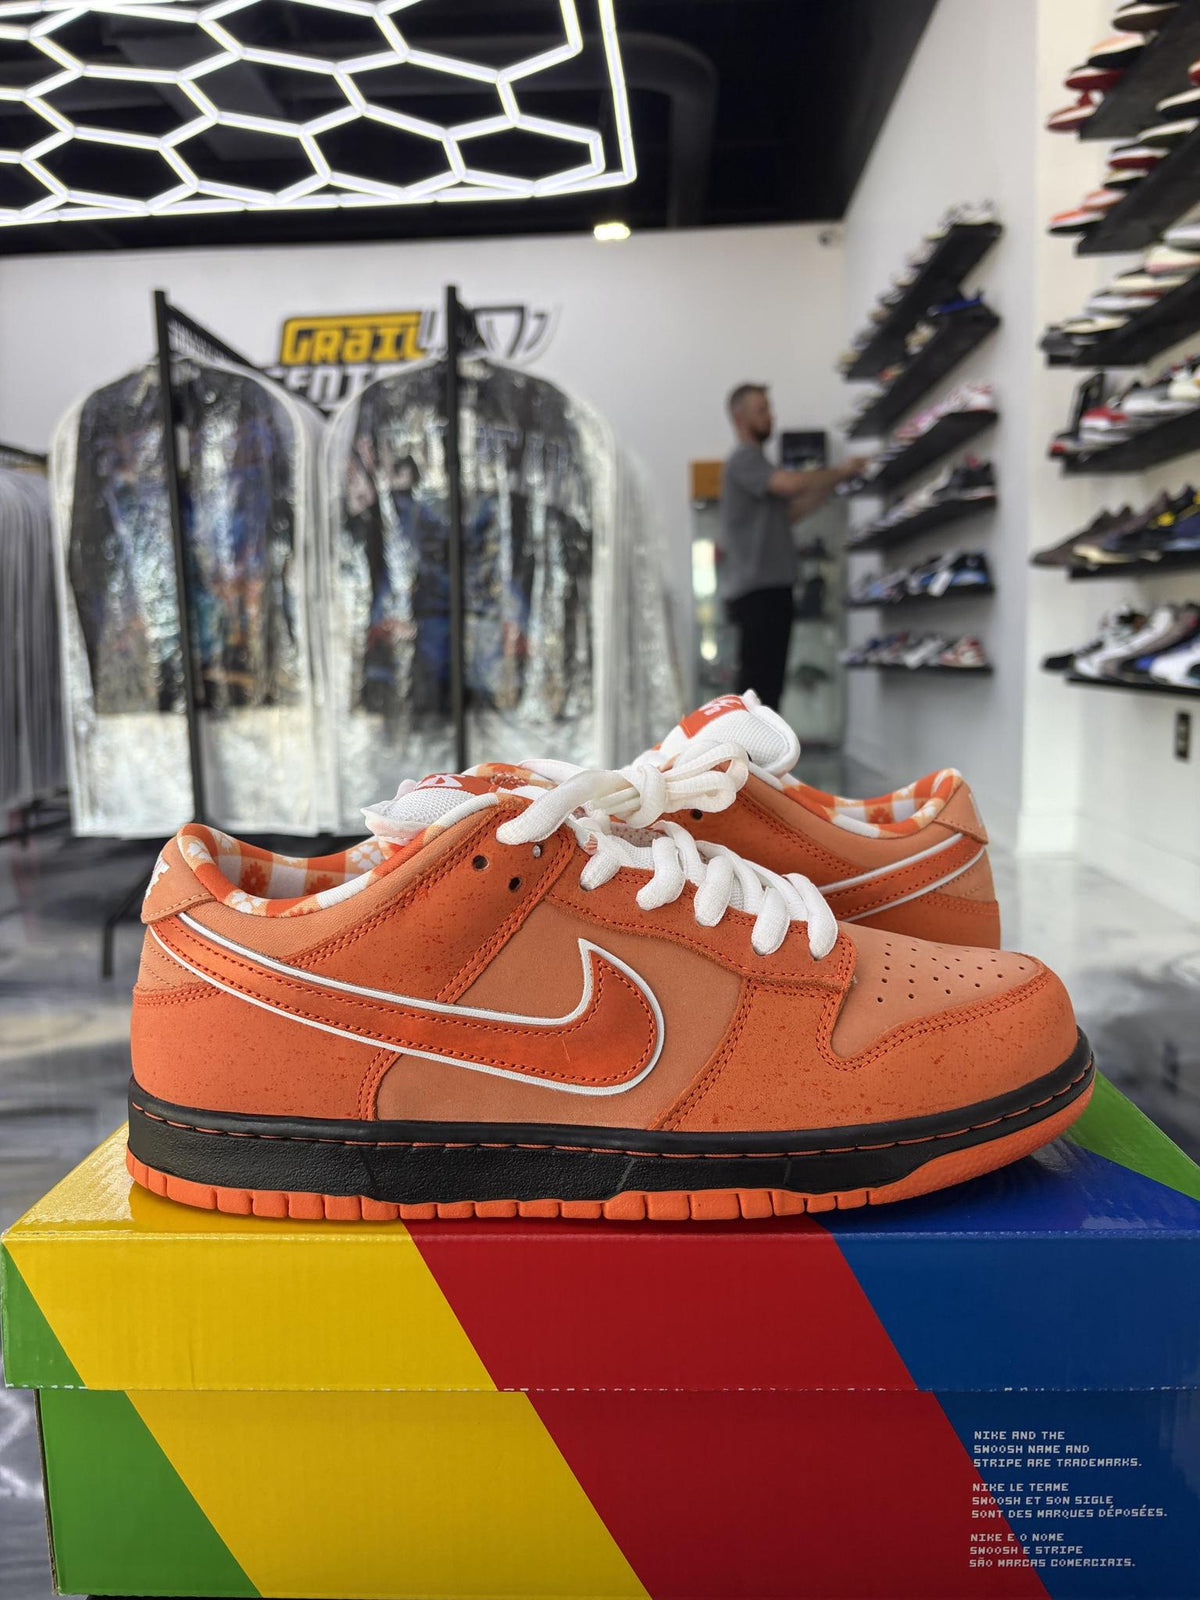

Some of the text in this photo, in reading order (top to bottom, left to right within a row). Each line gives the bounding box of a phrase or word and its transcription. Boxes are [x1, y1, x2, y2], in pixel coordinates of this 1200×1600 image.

[974, 1430, 1066, 1440] NIKE AND THE
[973, 1444, 1090, 1454] SWOOSH NAME AND
[972, 1457, 1143, 1468] STRIPE ARE TRADEMARKS.
[972, 1482, 1005, 1492] NIKE
[1009, 1482, 1024, 1492] LE
[971, 1495, 1114, 1506] SWOOSH ET SON SIGLE
[971, 1504, 1169, 1520] SONT DES MARQUES DÉPOSÉES.
[970, 1532, 1065, 1542] NIKE E O NOME
[969, 1545, 1084, 1555] SWOOSH E STRIPE
[969, 1556, 1136, 1568] SÃO MARCAS COMERCIAIS.
